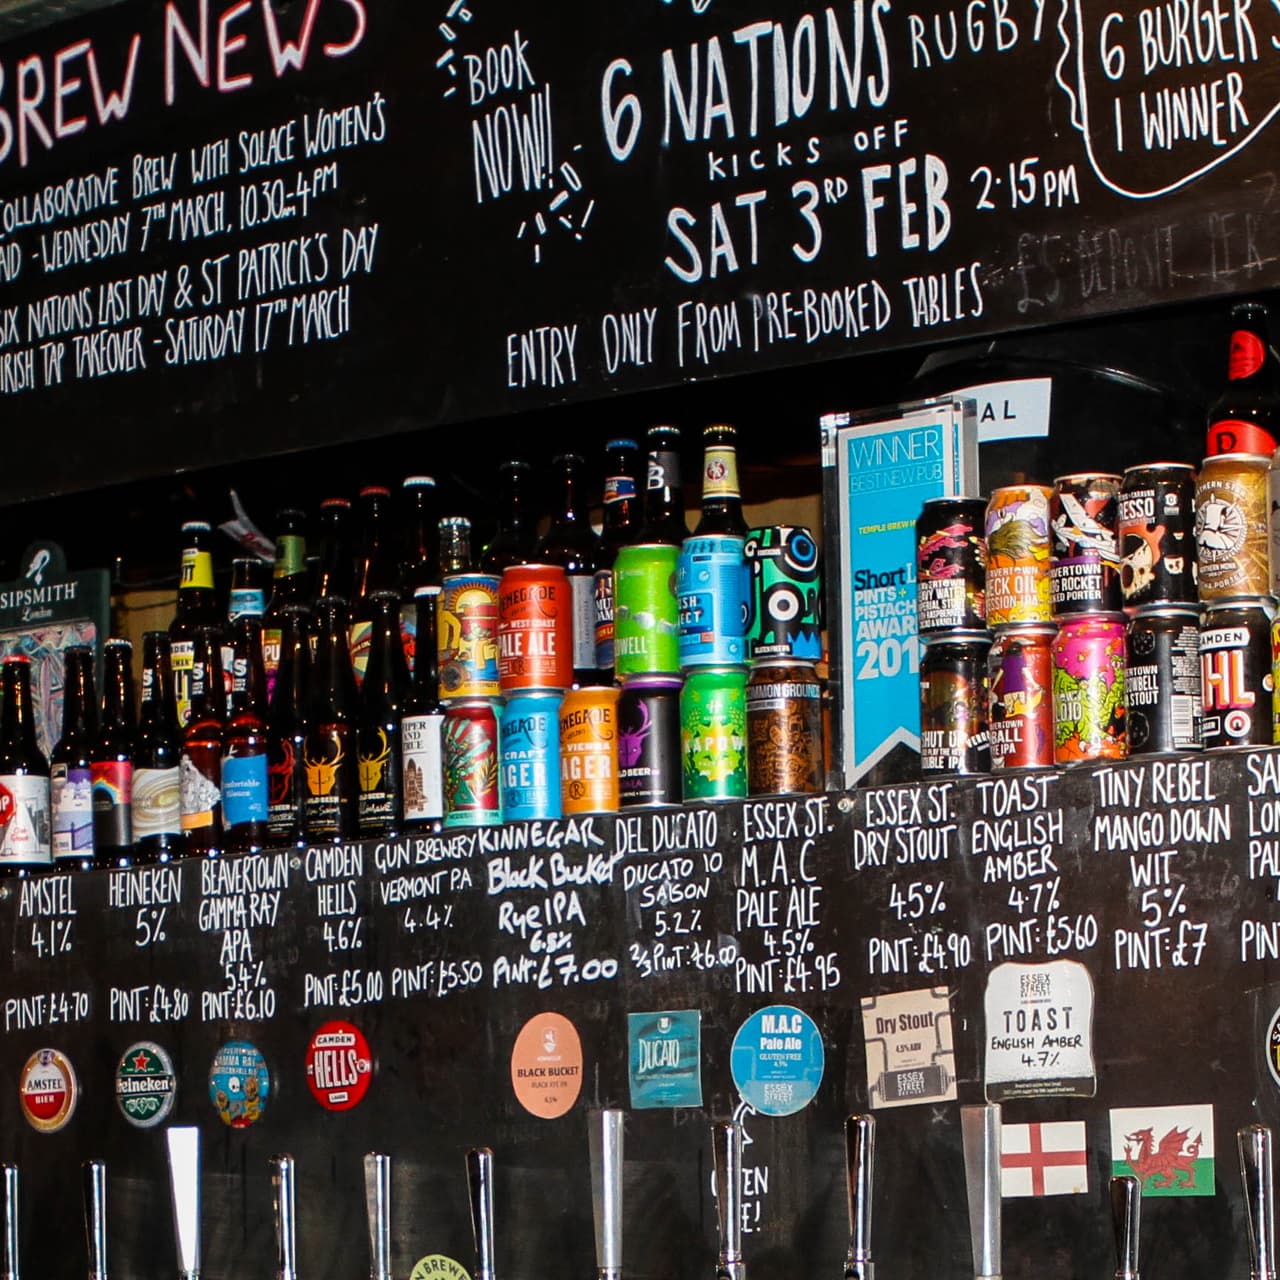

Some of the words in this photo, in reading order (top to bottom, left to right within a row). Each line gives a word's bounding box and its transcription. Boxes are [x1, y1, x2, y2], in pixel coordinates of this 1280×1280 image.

[165, 0, 366, 105] NEWS
[1100, 12, 1125, 80] 6
[463, 29, 536, 105] BOOK
[601, 58, 642, 161] 6
[662, 0, 891, 151] NATIONS
[908, 0, 1045, 68] RUGBY
[1140, 71, 1250, 150] WINNER
[132, 152, 177, 199] BREW
[191, 138, 229, 184] WITH
[238, 119, 296, 173] SOLACE
[303, 91, 386, 158] WOMEN'S
[708, 136, 820, 181] KICKS
[853, 119, 908, 151] OFF
[664, 189, 767, 283] SAT
[861, 153, 951, 258] FEB
[28, 287, 93, 342] NATIONS
[98, 278, 133, 325] LAST
[137, 270, 168, 317] DAY
[174, 264, 193, 309] &
[201, 253, 230, 306] ST
[238, 232, 329, 300] PATRICK'S
[342, 223, 379, 279] DAY
[0, 348, 35, 393] IRISH
[39, 341, 65, 386] TAP
[72, 326, 146, 378] TAKEOVER
[288, 284, 350, 345] MARCH
[507, 324, 577, 388] ENTRY
[602, 307, 657, 374] ONLY
[678, 300, 742, 368] FROM
[752, 279, 891, 352] PRE-BOOKED
[902, 261, 983, 328] TABLES
[852, 430, 939, 467] WINNER
[0, 582, 78, 610] SIPSMITH
[1061, 577, 1101, 593] ROCKET
[975, 774, 1060, 817] TOAST
[1091, 766, 1145, 808] TINY
[1152, 760, 1216, 804] REBEL
[743, 801, 799, 843] ESSEX
[865, 787, 923, 828] ESSEX
[1094, 811, 1165, 852] MANGO
[1170, 804, 1231, 845] DOWN
[477, 816, 605, 854] KINNEGAR
[616, 815, 648, 856] DEL
[652, 809, 718, 853] DUCATO
[853, 828, 890, 871] DRY
[894, 824, 957, 864] STOUT
[972, 808, 1063, 855] ENGLISH
[201, 852, 289, 896] BEAVERTOWN
[305, 844, 363, 882] CAMDEN
[374, 838, 411, 874] GUN
[415, 833, 477, 864] BREWERY
[983, 843, 1058, 883] AMBER
[1130, 849, 1178, 888] WIT
[19, 875, 77, 917] AMSTEL
[109, 867, 182, 908] HEINEKEN
[317, 879, 357, 917] HELLS
[379, 872, 441, 905] VERMONT
[640, 878, 709, 908] SAISON
[1141, 883, 1186, 928] 5%
[135, 907, 167, 947] 5%
[198, 894, 248, 932] GAMMA
[736, 888, 779, 932] PALE
[786, 885, 823, 930] ALE
[317, 1034, 353, 1046] CAMDEN
[761, 1014, 802, 1036] M.A.C
[876, 1017, 896, 1036] Dry
[898, 1013, 934, 1033] Stout
[1003, 1006, 1072, 1033] TOAST
[639, 1038, 679, 1072] DUCATO
[760, 1037, 782, 1050] Pale
[785, 1038, 802, 1050] Ale
[991, 1036, 1035, 1050] ENGLISH
[1041, 1034, 1082, 1049] AMBER
[26, 1078, 63, 1091] AMSTEL
[314, 1046, 357, 1089] HELLS
[517, 1066, 547, 1078] BLACK
[549, 1064, 579, 1077] BUCKET
